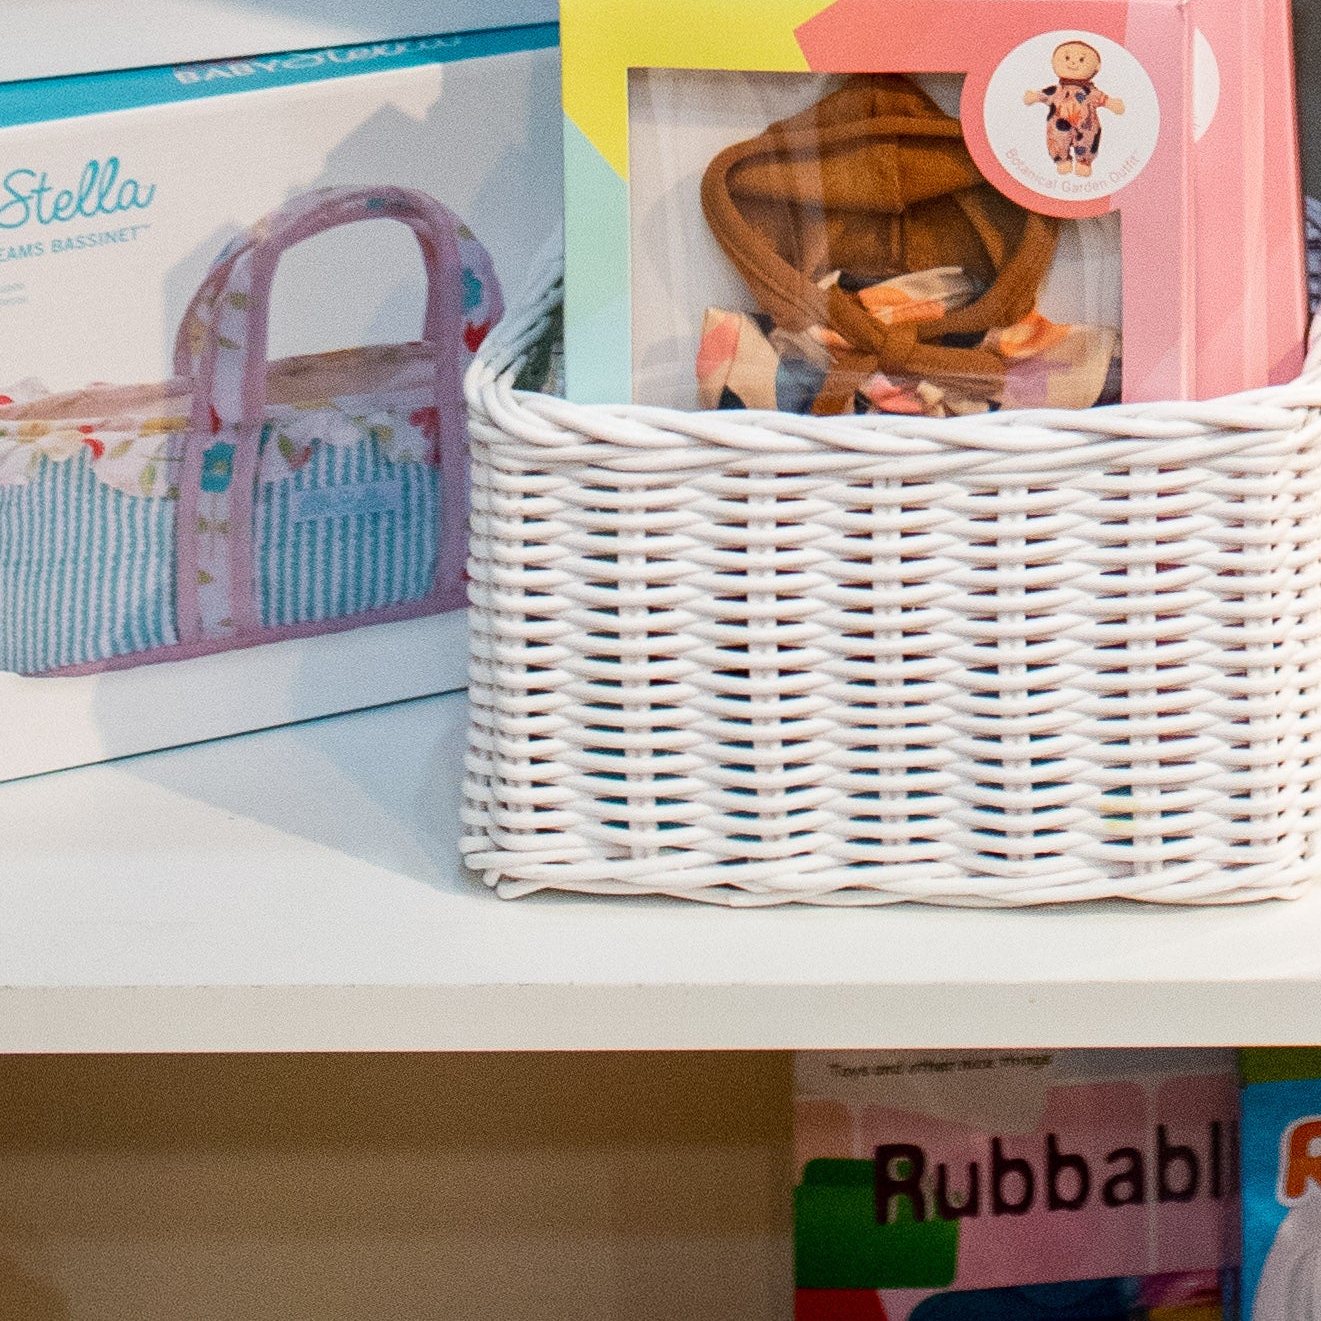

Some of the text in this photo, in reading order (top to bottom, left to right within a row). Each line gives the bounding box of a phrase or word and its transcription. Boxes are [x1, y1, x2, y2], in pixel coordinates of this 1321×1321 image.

[1006, 147, 1141, 193] Botanical Garden Outfit
[52, 225, 138, 254] BASSINET
[874, 1121, 1221, 1225] Rubbabl
